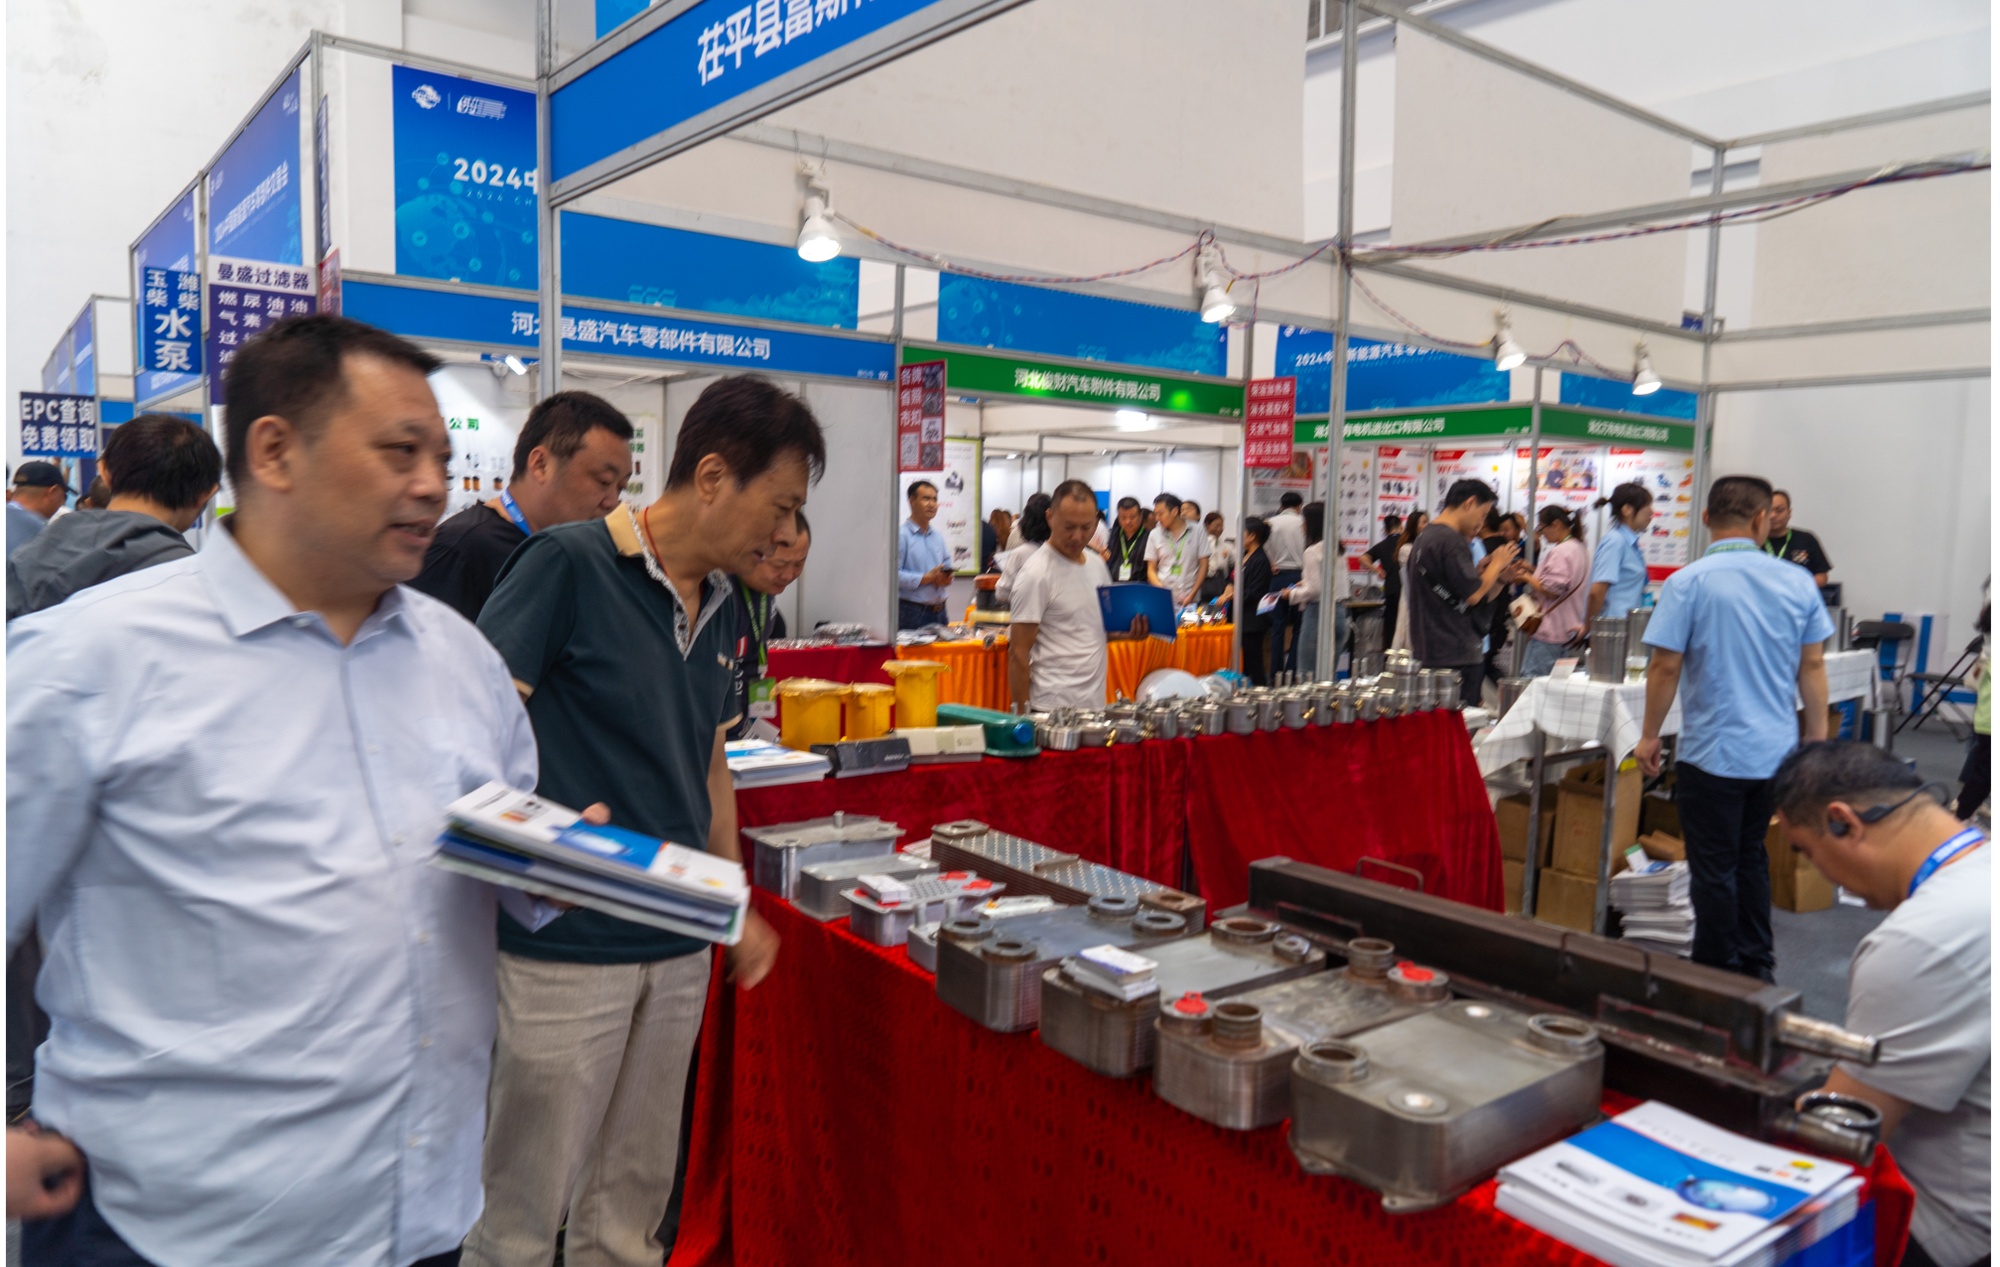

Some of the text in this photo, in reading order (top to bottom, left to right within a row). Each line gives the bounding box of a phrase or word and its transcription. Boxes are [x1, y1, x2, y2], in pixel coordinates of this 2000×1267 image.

[146, 269, 168, 307] 玉柴
[178, 273, 201, 310] 潍柴
[217, 262, 310, 291] 曼盛过滤器
[154, 309, 192, 371] 水泵
[511, 310, 771, 361] 河曼盛汽车零部件有限公司
[21, 397, 96, 426] EPC查询
[22, 424, 97, 453] 免费领取
